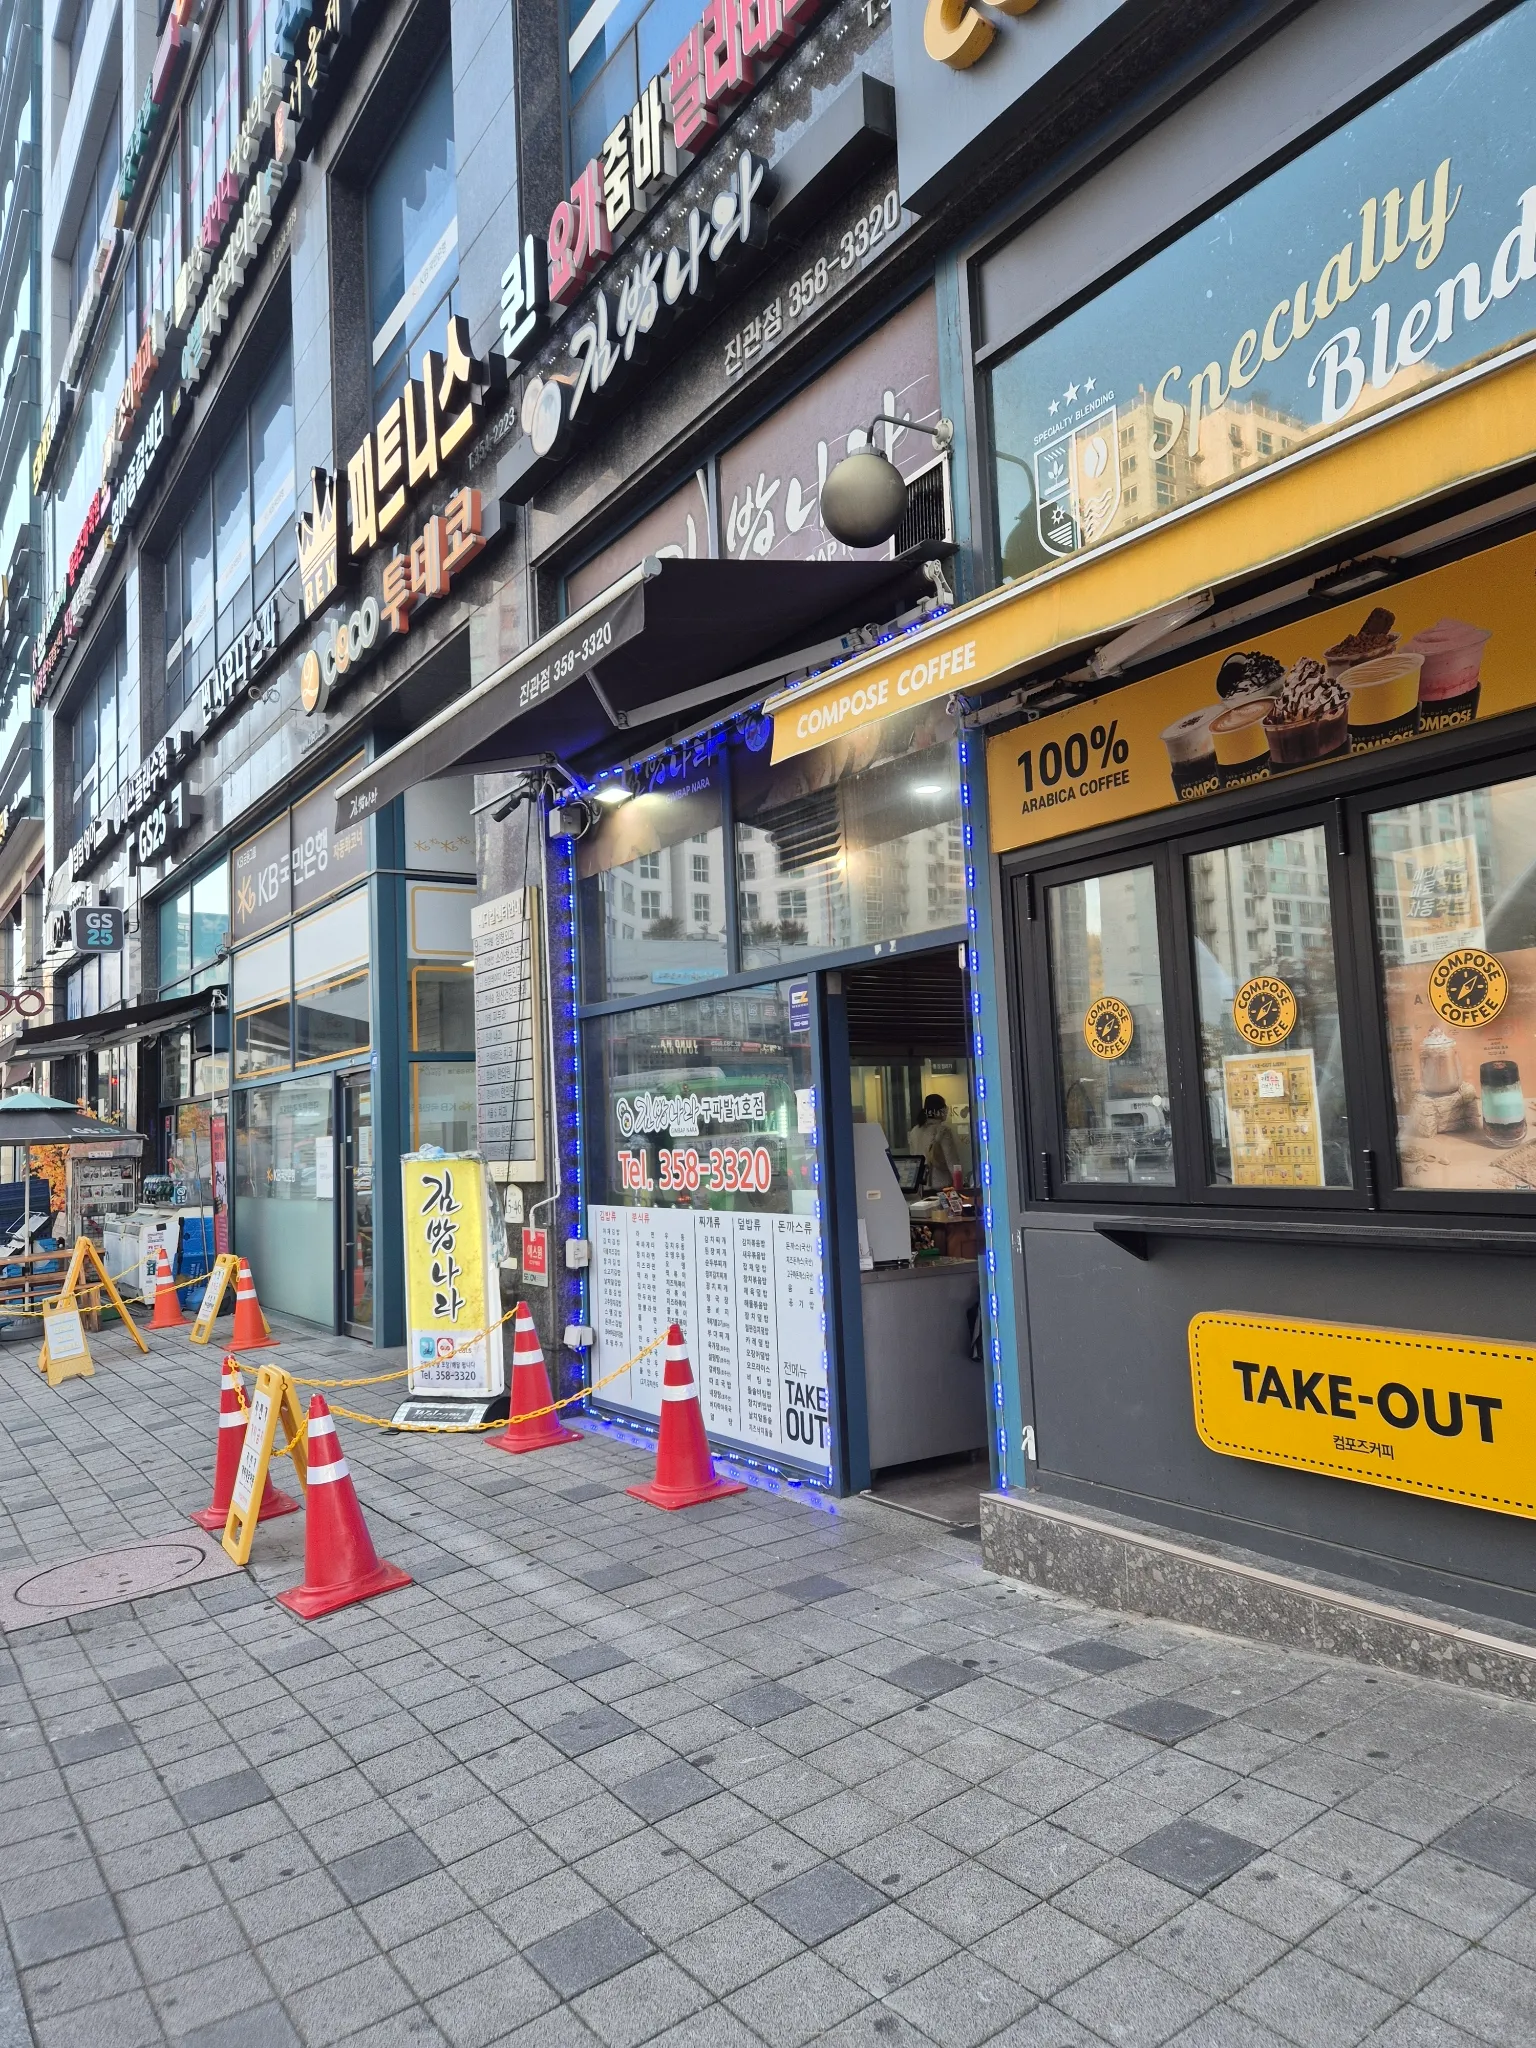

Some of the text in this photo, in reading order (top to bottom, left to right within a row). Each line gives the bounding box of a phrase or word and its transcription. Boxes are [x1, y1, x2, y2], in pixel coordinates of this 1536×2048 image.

[548, 158, 604, 301] 요가
[602, 75, 667, 233] 줌바
[724, 190, 901, 378] 진관점 358-3320
[1033, 390, 1115, 446] SPECIALTY BLENDING
[347, 314, 474, 555] 피트니스
[381, 486, 484, 634] 투데코
[304, 552, 337, 611] REX
[519, 621, 612, 708] 진관점 358-3320
[796, 641, 976, 739] COMPOSE COFFEE
[1419, 708, 1472, 732] OMPOSE
[1017, 720, 1129, 794] 100%
[691, 777, 711, 793] NARA
[1021, 770, 1130, 815] ARABICA COFFEE
[139, 800, 167, 863] GS25
[86, 912, 113, 929] GS
[87, 929, 113, 945] 25
[1433, 952, 1501, 988] COMPOSE
[1238, 979, 1291, 1010] COMPOSE
[1087, 999, 1129, 1027] COMPOSE
[1441, 997, 1499, 1025] COFFEE
[1091, 1036, 1127, 1055] COFFEE
[1243, 1021, 1288, 1042] COFFEE
[702, 1096, 764, 1120] 구파발1호점
[618, 1149, 770, 1191] Tel. 358-3320
[600, 1211, 616, 1221] 김밥류
[632, 1212, 650, 1224] 분식류
[699, 1216, 720, 1228] 찌개류
[738, 1218, 761, 1231] 덮밥류
[778, 1220, 812, 1235] 돈까스류
[421, 1370, 476, 1381] Tel. 358-3320
[784, 1361, 807, 1378] 전메뉴
[785, 1380, 828, 1412] TAKE
[1232, 1360, 1503, 1444] TAKE-OUT
[786, 1408, 828, 1448] OUT
[1332, 1434, 1395, 1460] 컴포즈커피
